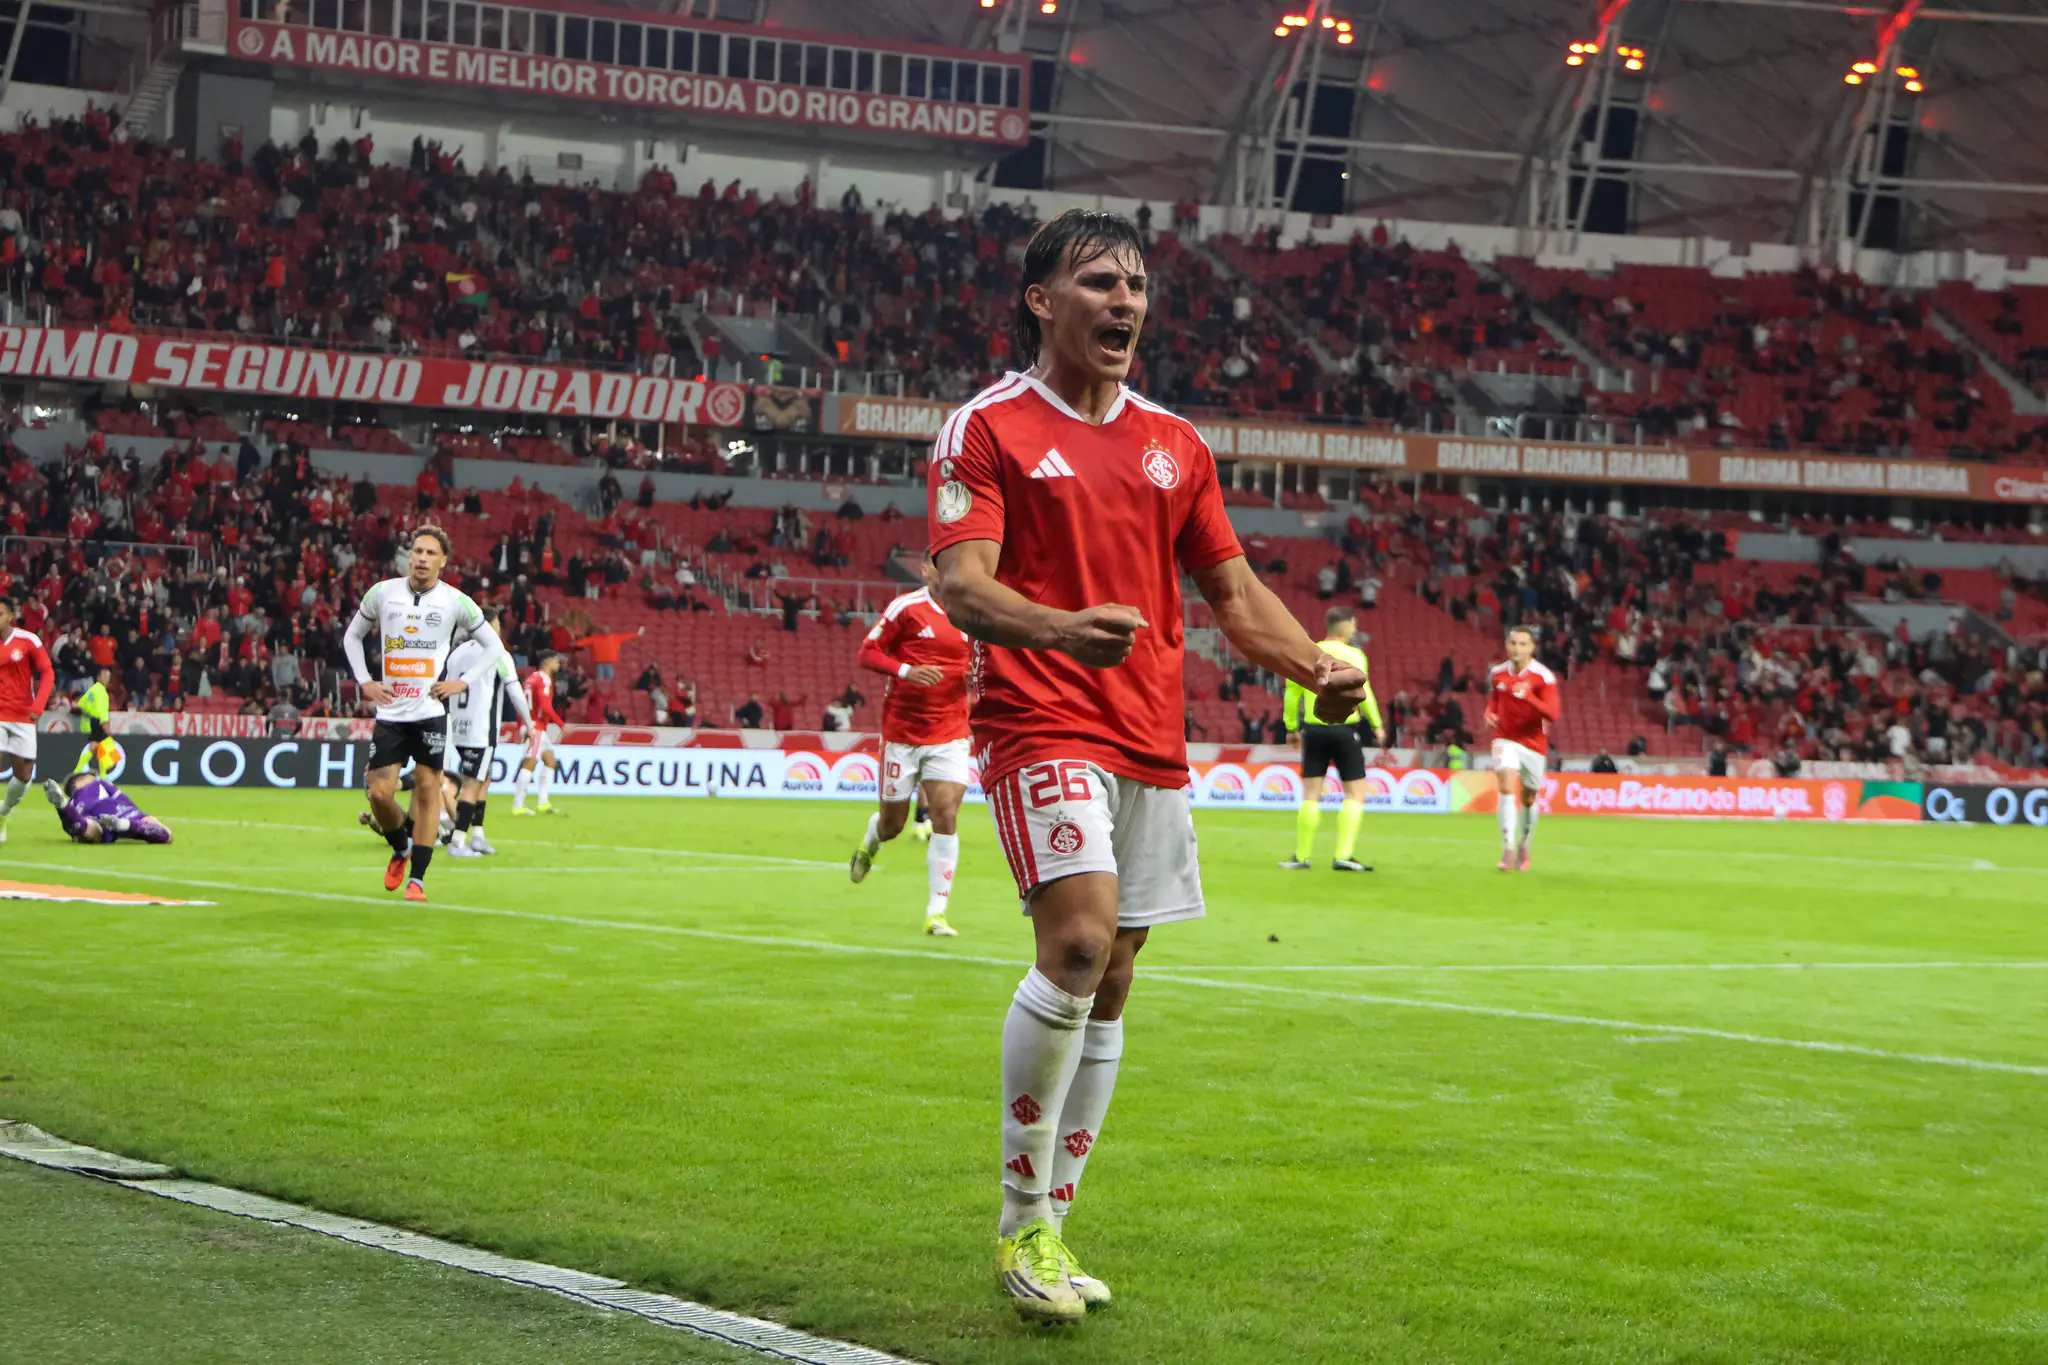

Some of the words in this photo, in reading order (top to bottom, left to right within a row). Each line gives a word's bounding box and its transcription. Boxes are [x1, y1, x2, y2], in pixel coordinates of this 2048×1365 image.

[270, 29, 295, 60] A
[306, 33, 419, 75] MAIOR
[429, 48, 450, 78] E
[456, 53, 597, 97] MELHOR
[604, 68, 747, 113] TORCIDA
[756, 86, 799, 118] DO
[805, 91, 861, 125] RIO
[866, 98, 998, 138] GRANDE
[147, 340, 423, 401] SEGUNDO
[443, 363, 704, 424] JOGADOR
[856, 402, 942, 434] BRAHMA
[1238, 428, 1320, 459] BRAHMA
[1323, 433, 1406, 466] BRAHMA
[1437, 441, 1519, 472] BRAHMA
[1522, 446, 1604, 477] BRAHMA
[1607, 451, 1690, 482] BRAHMA
[1719, 456, 1800, 486] BRAHMA
[1803, 460, 1884, 489] BRAHMA
[1887, 463, 1970, 494] BRAHMA
[553, 758, 766, 788] MASCULINA
[783, 780, 823, 791] Aurora
[837, 781, 877, 792] Aurora
[886, 761, 901, 779] 10
[1026, 761, 1092, 809] 26
[1565, 781, 1617, 812] Copa
[1617, 780, 1709, 811] Betano
[1709, 785, 1736, 811] do
[1737, 786, 1813, 813] BRASIL
